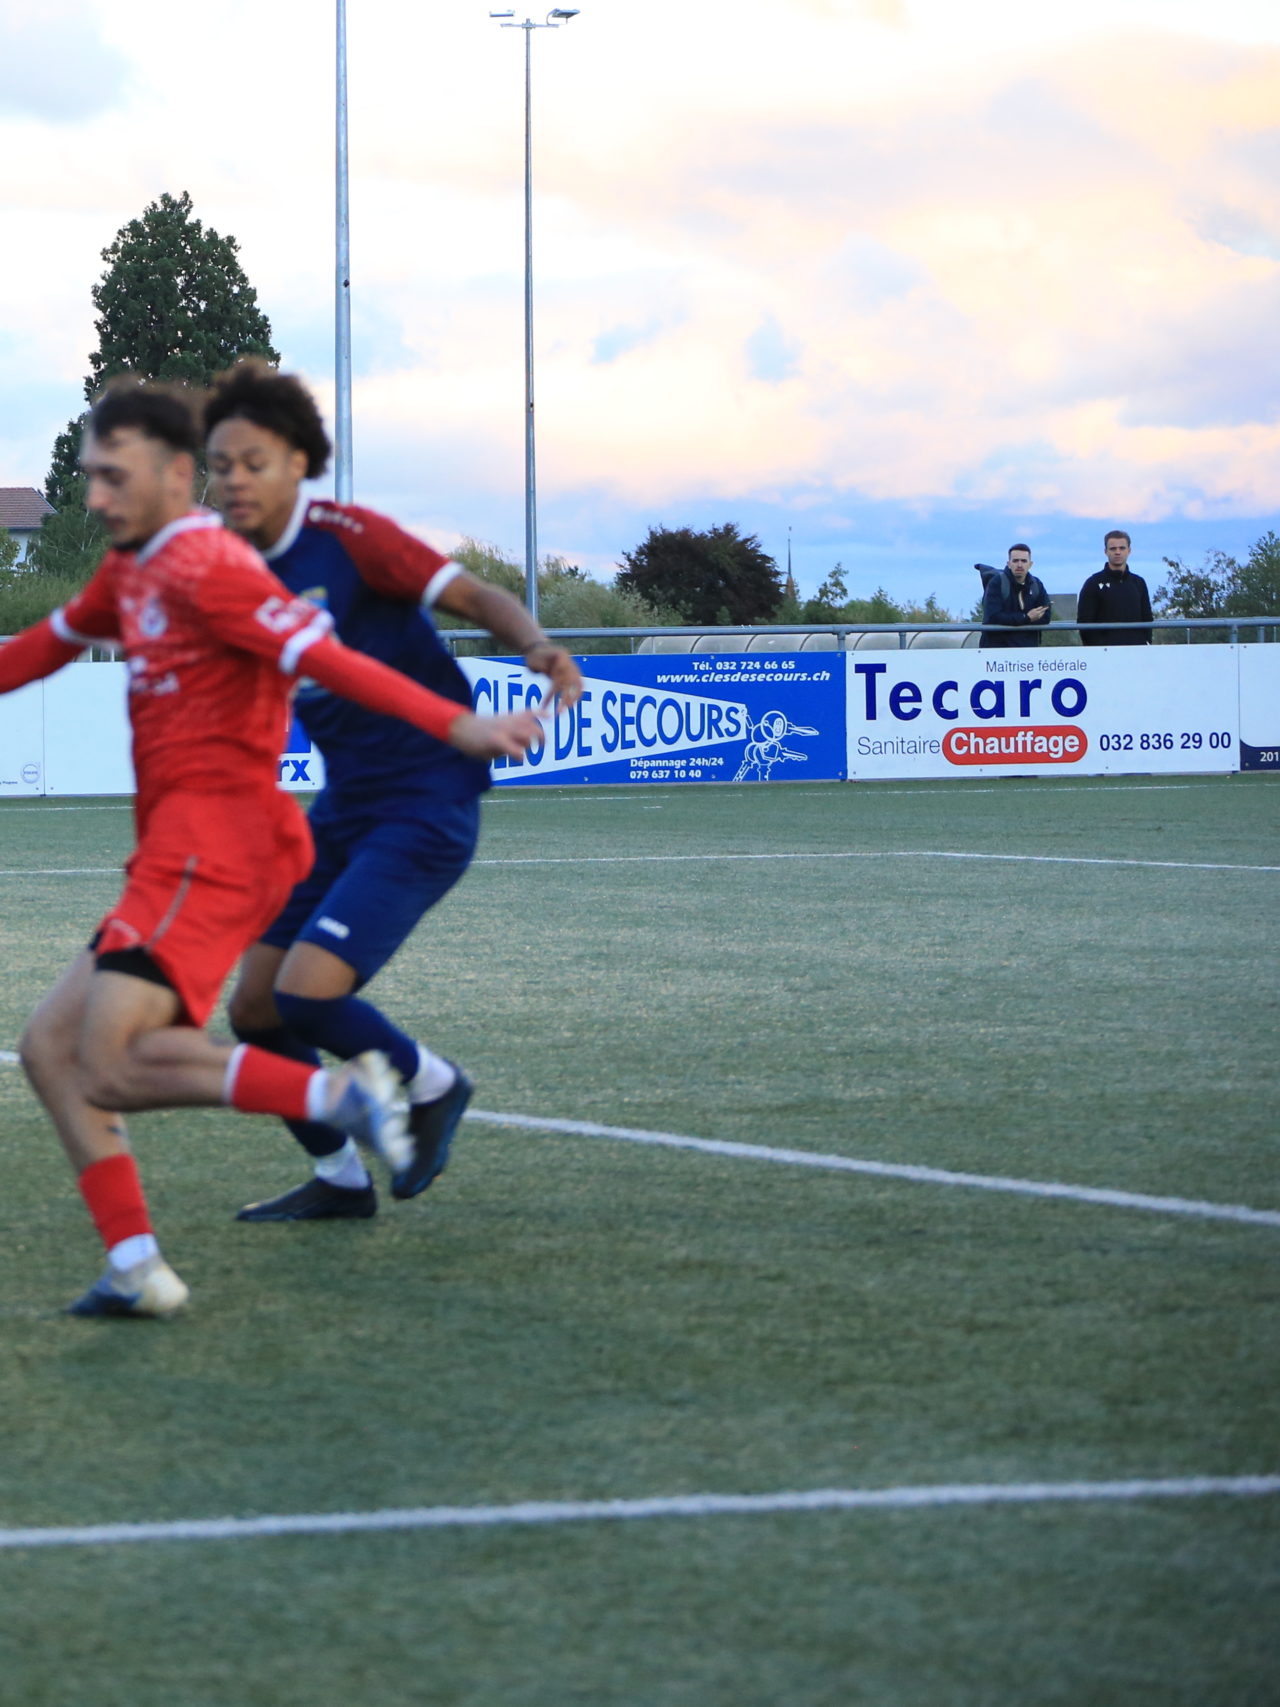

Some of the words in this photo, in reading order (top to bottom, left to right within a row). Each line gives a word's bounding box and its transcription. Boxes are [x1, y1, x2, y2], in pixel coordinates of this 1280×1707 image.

[693, 661, 712, 671] Tél.
[716, 661, 737, 671] 032
[741, 661, 761, 670] 724
[764, 661, 778, 670] 66
[781, 661, 795, 670] 65
[986, 661, 1034, 673] Maîtrise
[1038, 659, 1088, 671] fédérale
[656, 671, 831, 683] www.clesdesecours.ch
[854, 663, 1088, 721] Tecaro
[554, 690, 593, 761] DE
[601, 690, 741, 753] SECOURS
[857, 736, 941, 756] Sanitaire
[950, 731, 1081, 758] Chauffage
[1100, 734, 1134, 751] 032
[1140, 733, 1174, 750] 836
[1180, 733, 1203, 749] 29
[1209, 732, 1231, 749] 00
[630, 758, 687, 769] Dépannage
[689, 757, 724, 767] 24h/24
[630, 770, 649, 779] 079
[651, 769, 670, 779] 637
[674, 769, 686, 778] 10
[689, 769, 702, 778] 40
